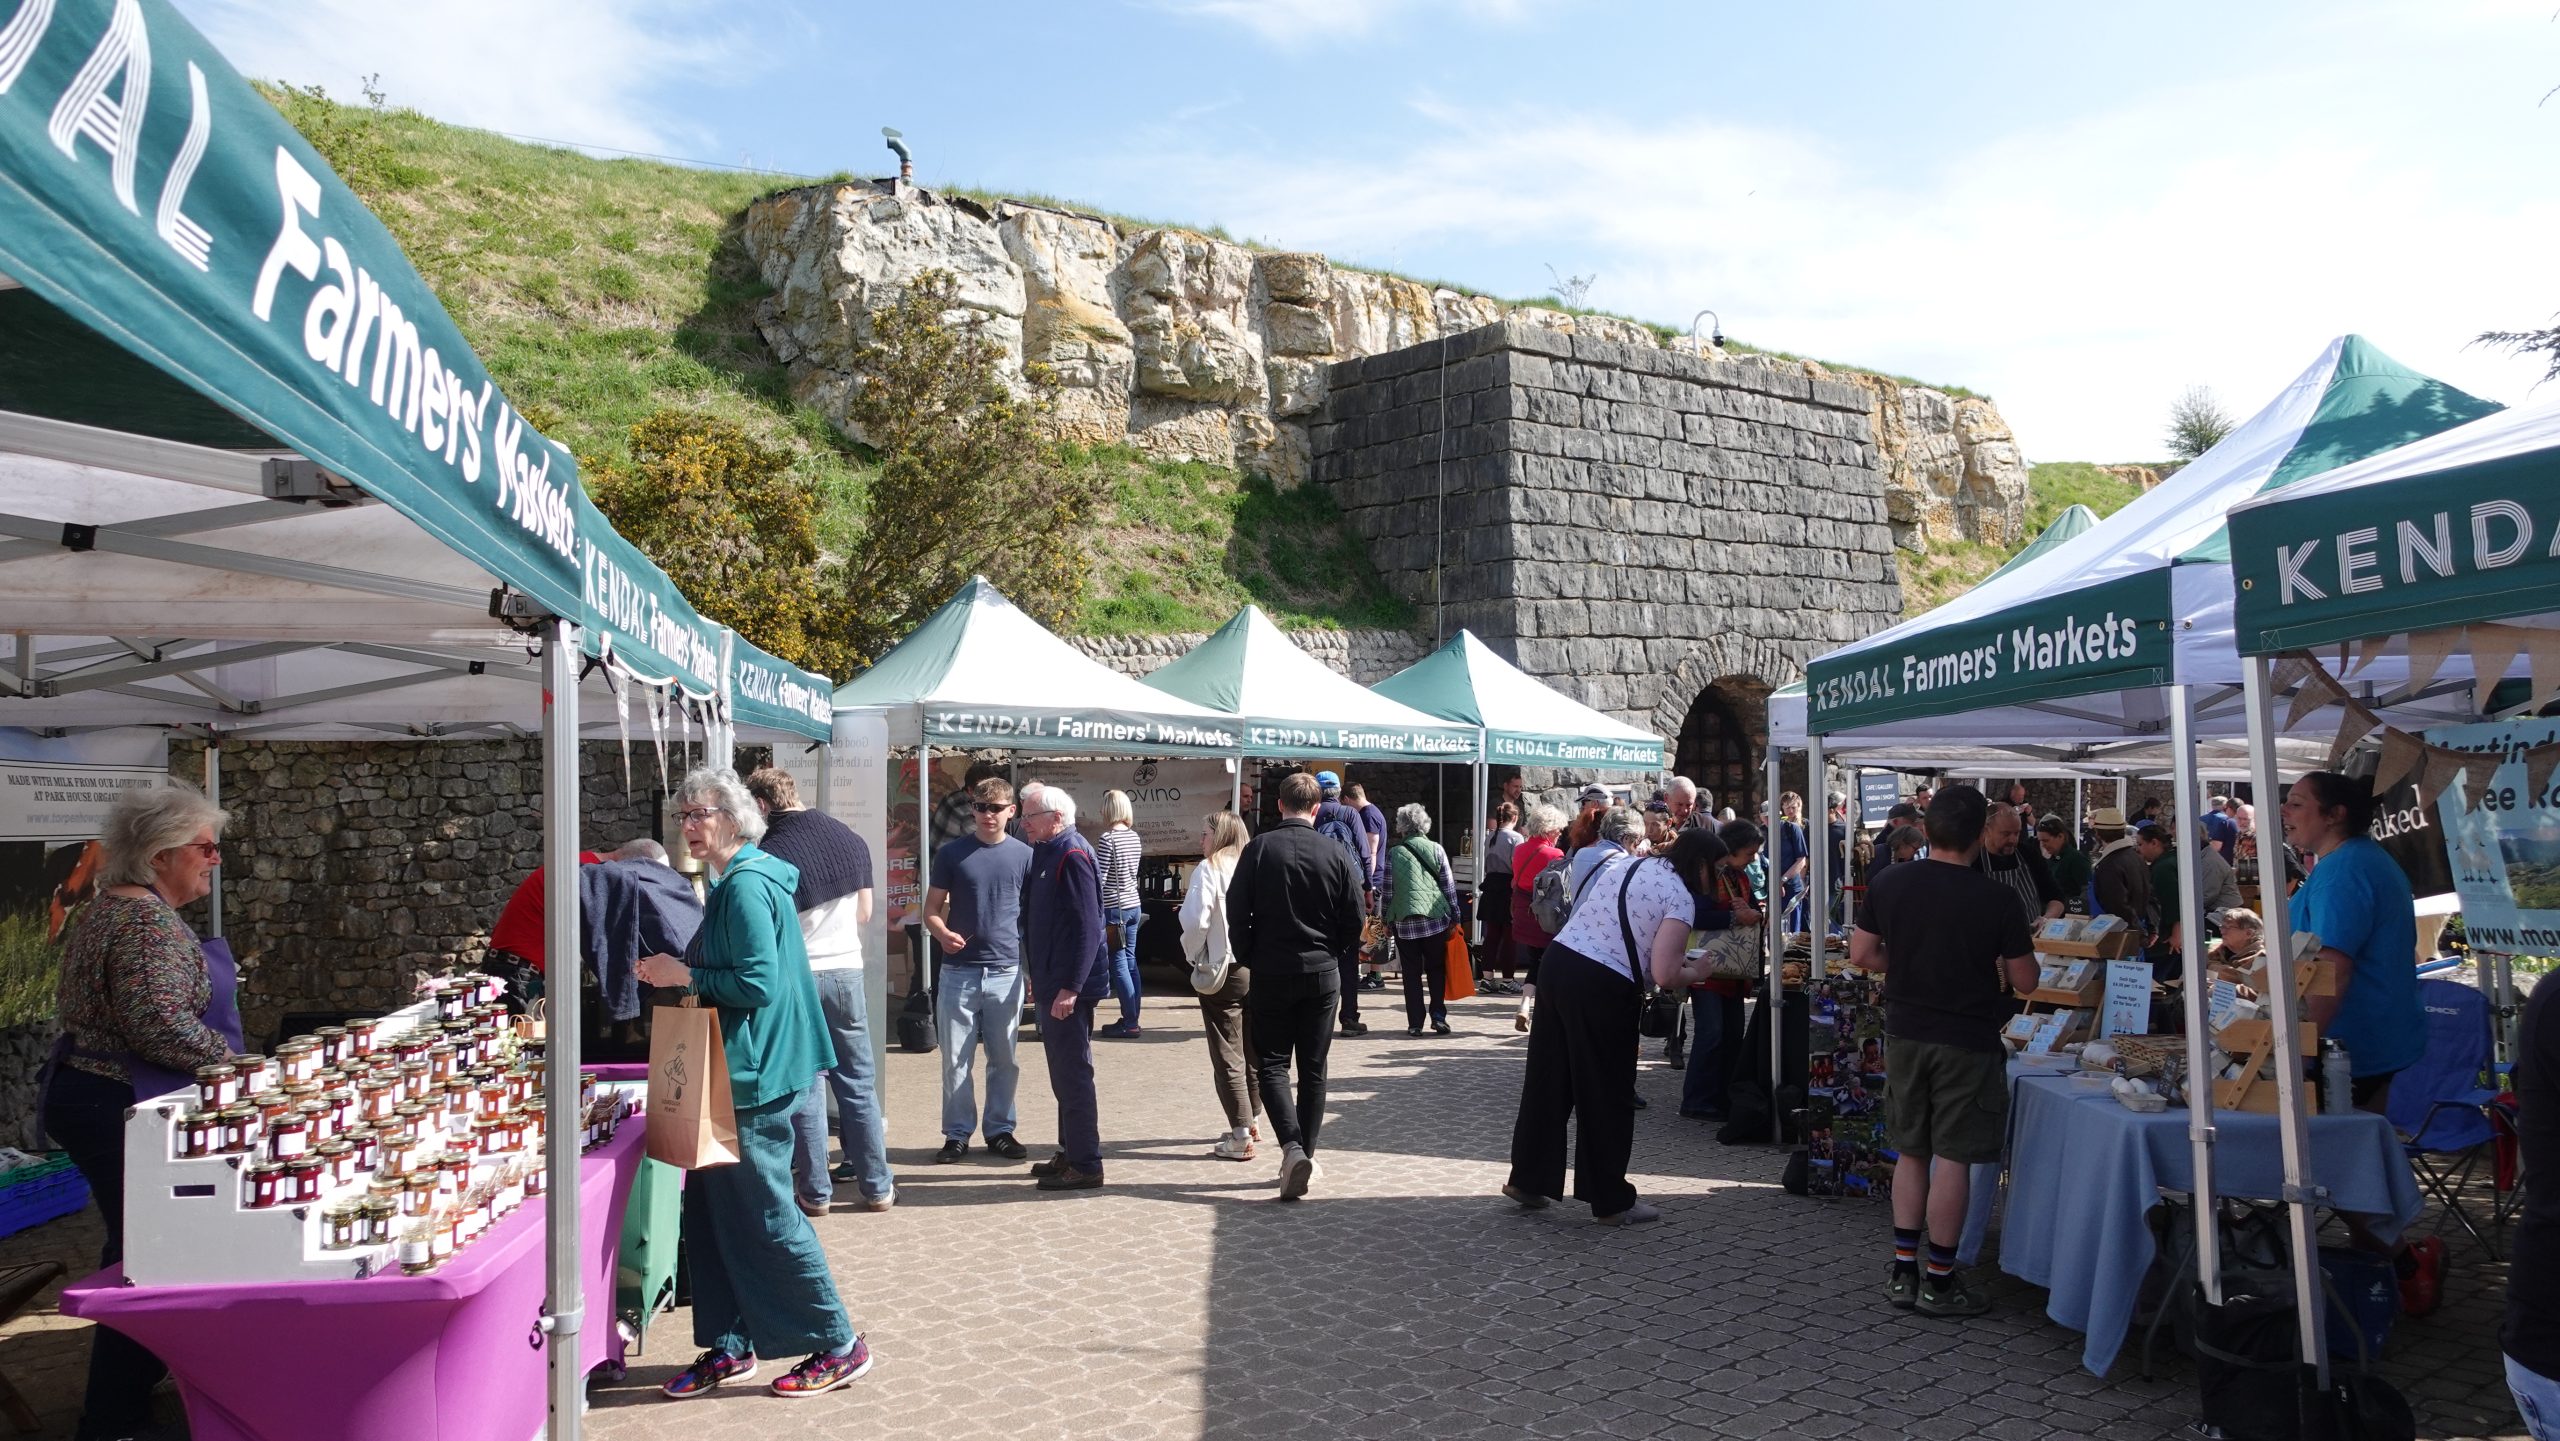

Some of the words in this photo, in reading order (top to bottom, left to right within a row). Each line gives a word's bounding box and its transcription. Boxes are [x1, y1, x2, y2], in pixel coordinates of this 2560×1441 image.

[252, 144, 492, 483] Farmers'
[494, 401, 581, 570] Markets
[2277, 499, 2560, 606] KEND
[585, 537, 648, 644] KENDAL
[649, 592, 691, 670] Farmers'
[690, 627, 718, 689] Markets
[1817, 664, 1896, 712] KENDAL
[1902, 633, 2003, 694] Farmers'
[2012, 611, 2137, 674] Markets
[739, 659, 779, 707] KENDAL
[778, 672, 811, 716] Farmers'
[939, 712, 1047, 737] KENDAL
[1057, 716, 1150, 742] Farmers'
[1157, 724, 1234, 748] Markets
[1251, 727, 1332, 748] KENDAL
[1338, 729, 1409, 750] Farmers'
[1412, 734, 1472, 753] Markets
[1495, 738, 1554, 757] KENDAL
[1557, 741, 1611, 761] Farmers'
[1612, 744, 1658, 763] Markets
[7, 774, 31, 786] MADE
[32, 776, 54, 787] WITH
[54, 777, 73, 788] MILK
[74, 778, 97, 788] FROM
[98, 778, 115, 788] OUR
[34, 791, 43, 801] AT
[44, 791, 66, 802] PARK
[66, 792, 92, 802] HOUSE
[1102, 787, 1181, 803] ovino
[2368, 783, 2429, 841] aked
